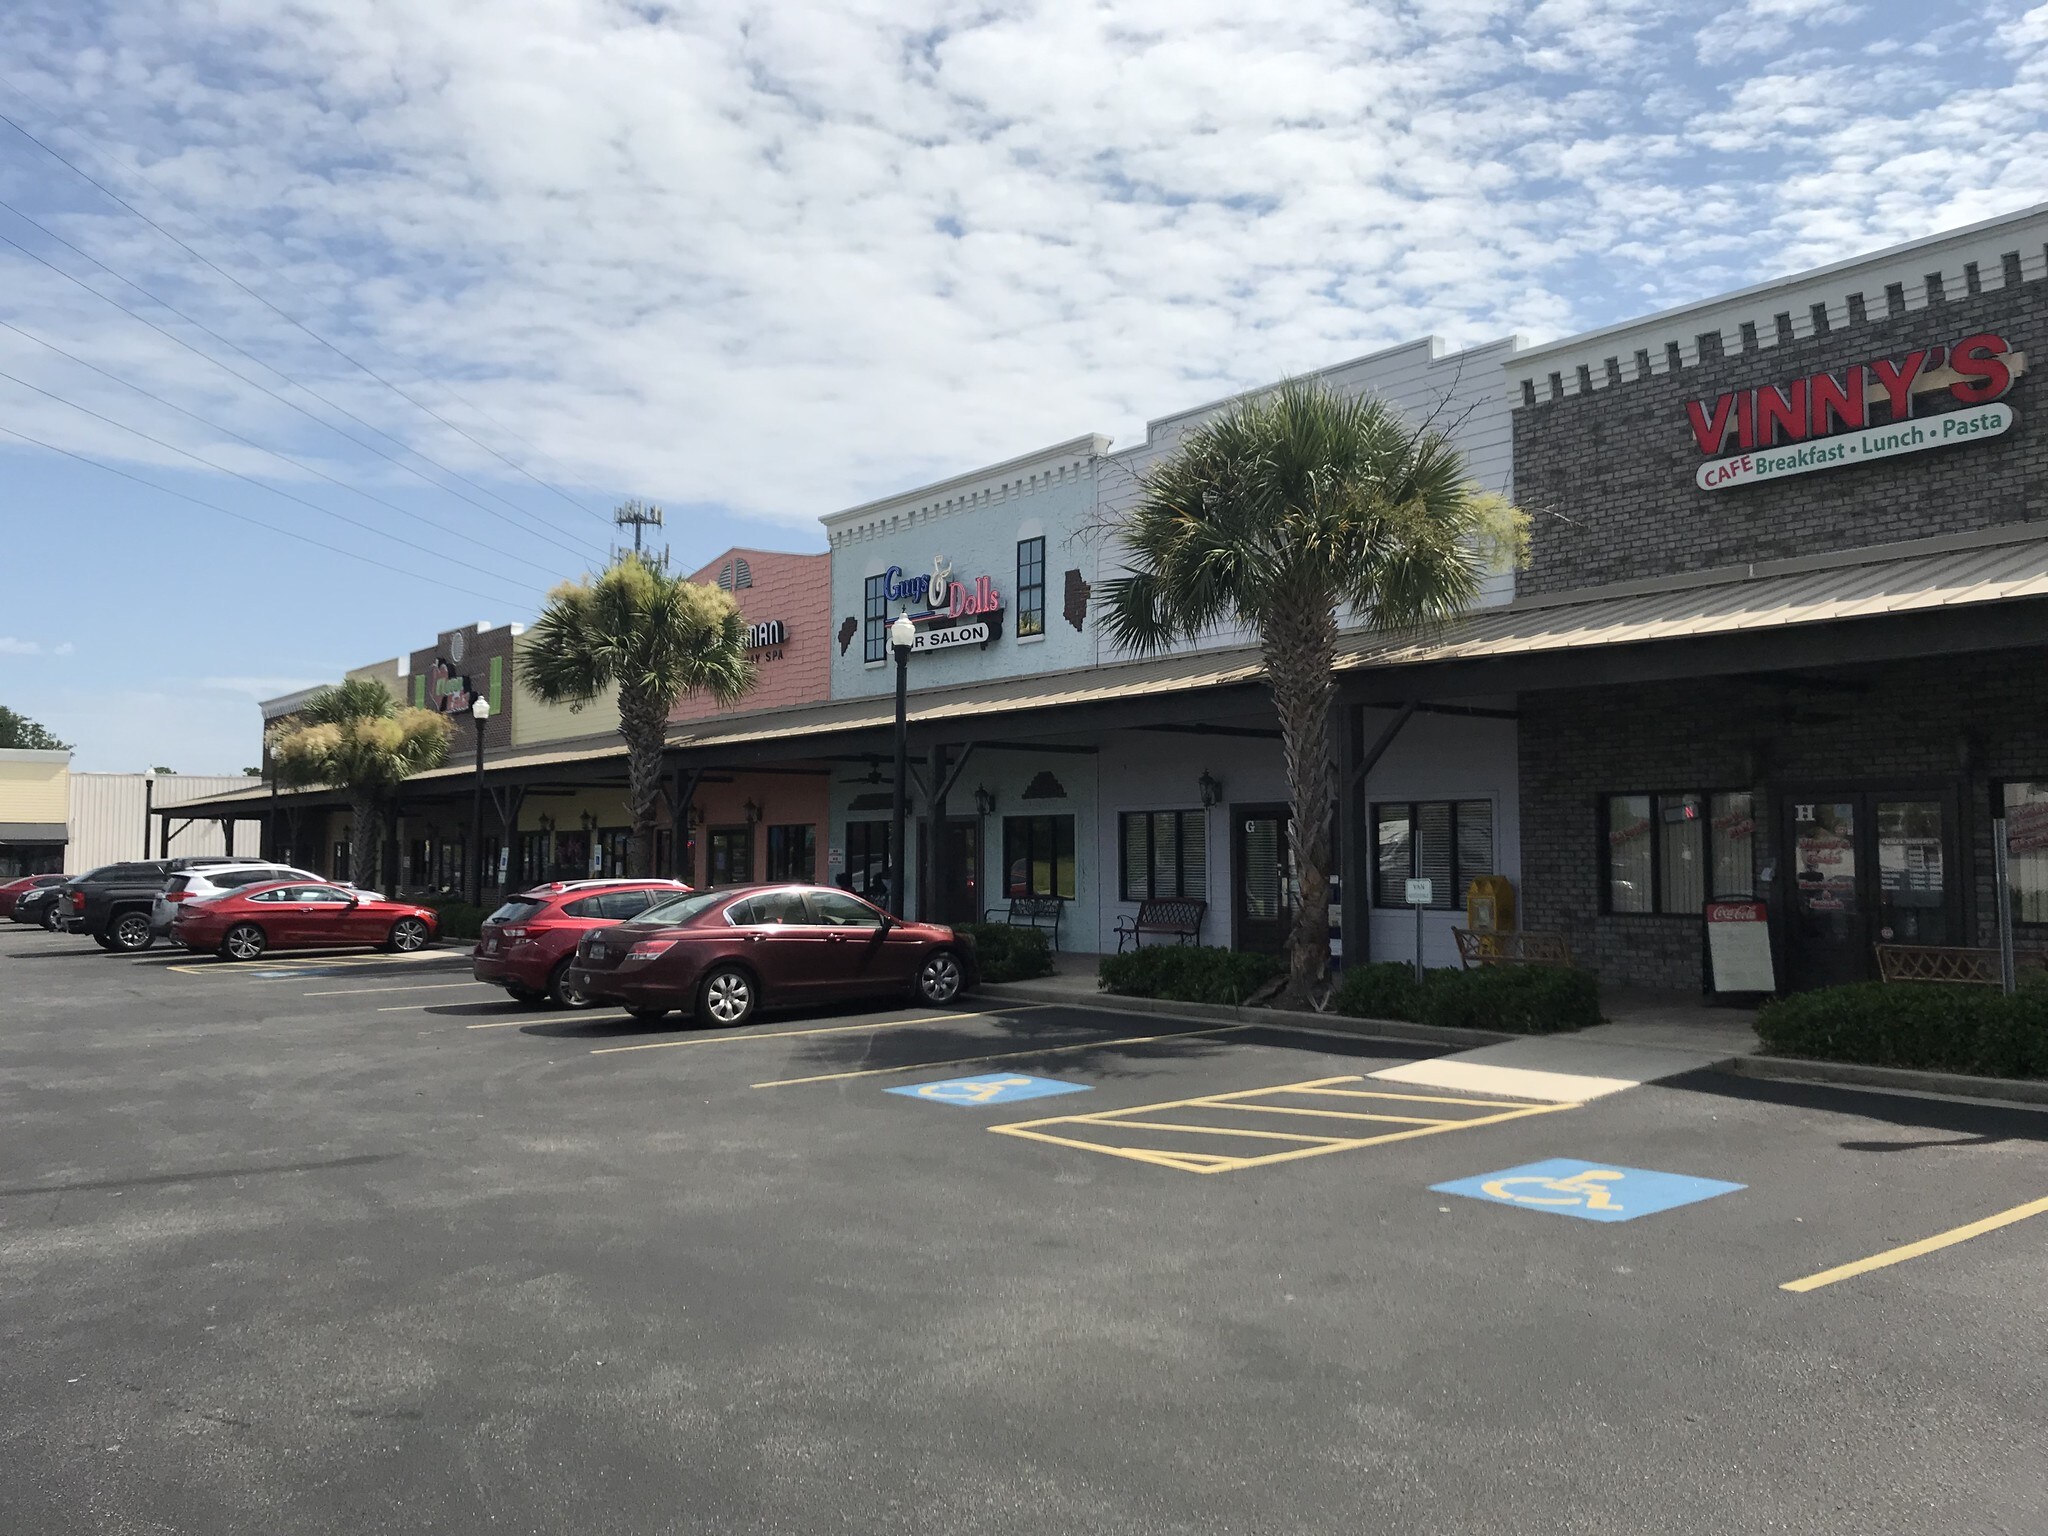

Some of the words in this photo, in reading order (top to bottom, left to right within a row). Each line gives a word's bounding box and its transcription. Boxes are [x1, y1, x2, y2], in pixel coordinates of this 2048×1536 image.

[1685, 333, 2013, 455] VINNY'S
[1704, 455, 1753, 487] CAFE
[1755, 443, 1845, 475] Breakfast
[1861, 426, 1924, 455] Lunch
[1942, 412, 2003, 438] Pasta
[884, 565, 931, 604] Guys
[948, 575, 999, 619] Dolls
[930, 626, 983, 646] SALON
[765, 650, 784, 662] SPA
[1795, 804, 1815, 821] H
[1245, 820, 1256, 833] G
